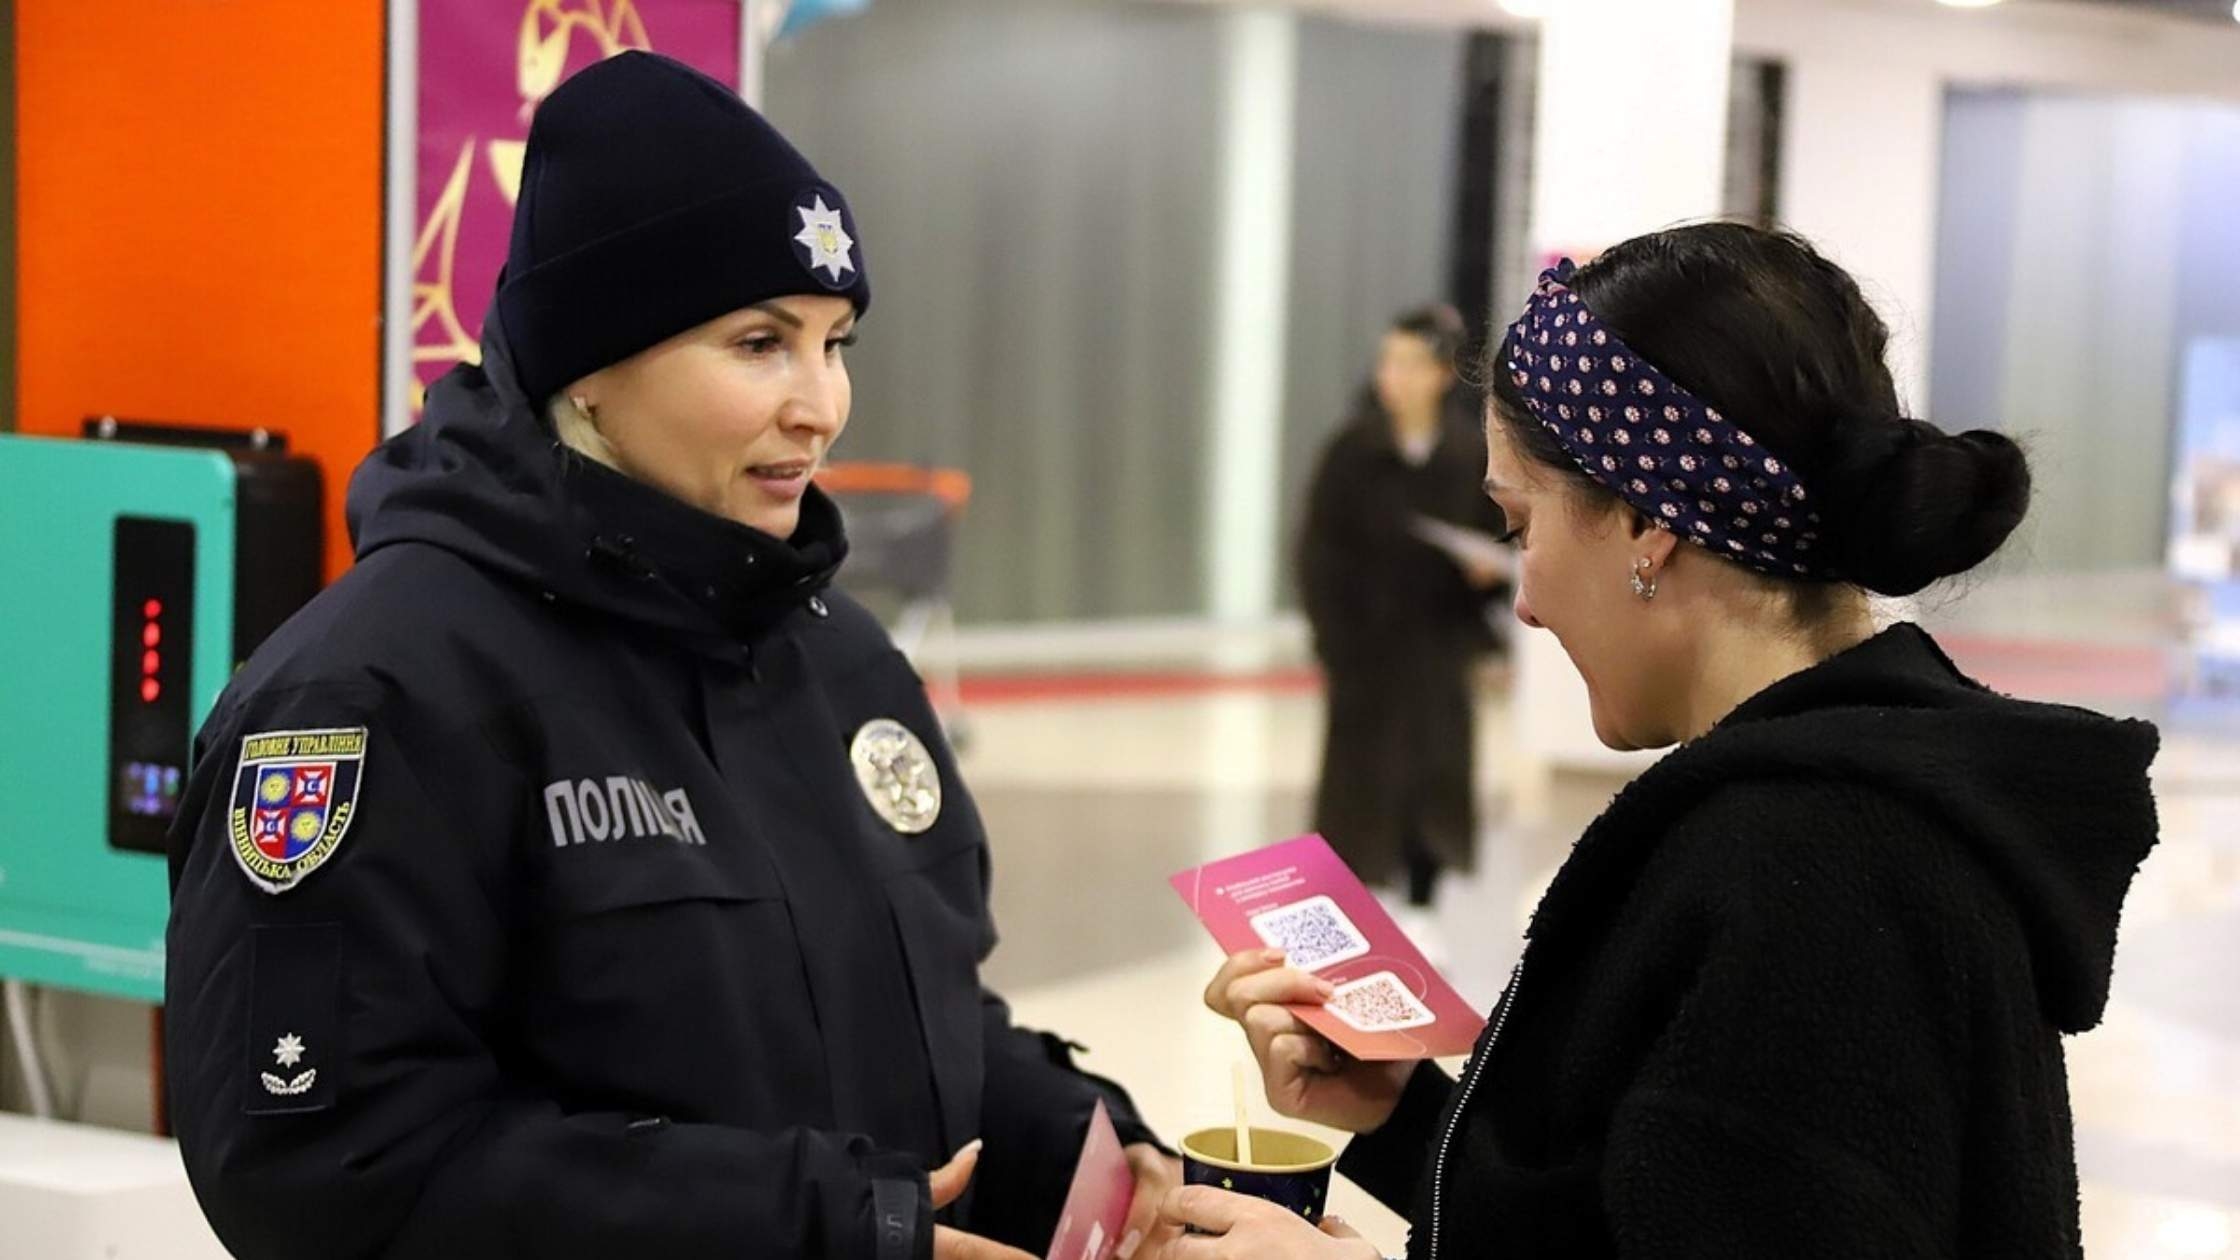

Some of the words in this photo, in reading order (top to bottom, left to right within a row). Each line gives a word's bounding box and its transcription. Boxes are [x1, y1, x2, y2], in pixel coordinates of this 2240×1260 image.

[245, 736, 290, 758] ГОЛОВНЕ
[291, 734, 363, 755] УПРАВЛІННЯ
[234, 806, 292, 879] ВІННИЦЬКА
[296, 801, 351, 873] ОБЛАСТЬ
[544, 776, 707, 847] ПОЛІЦЯ
